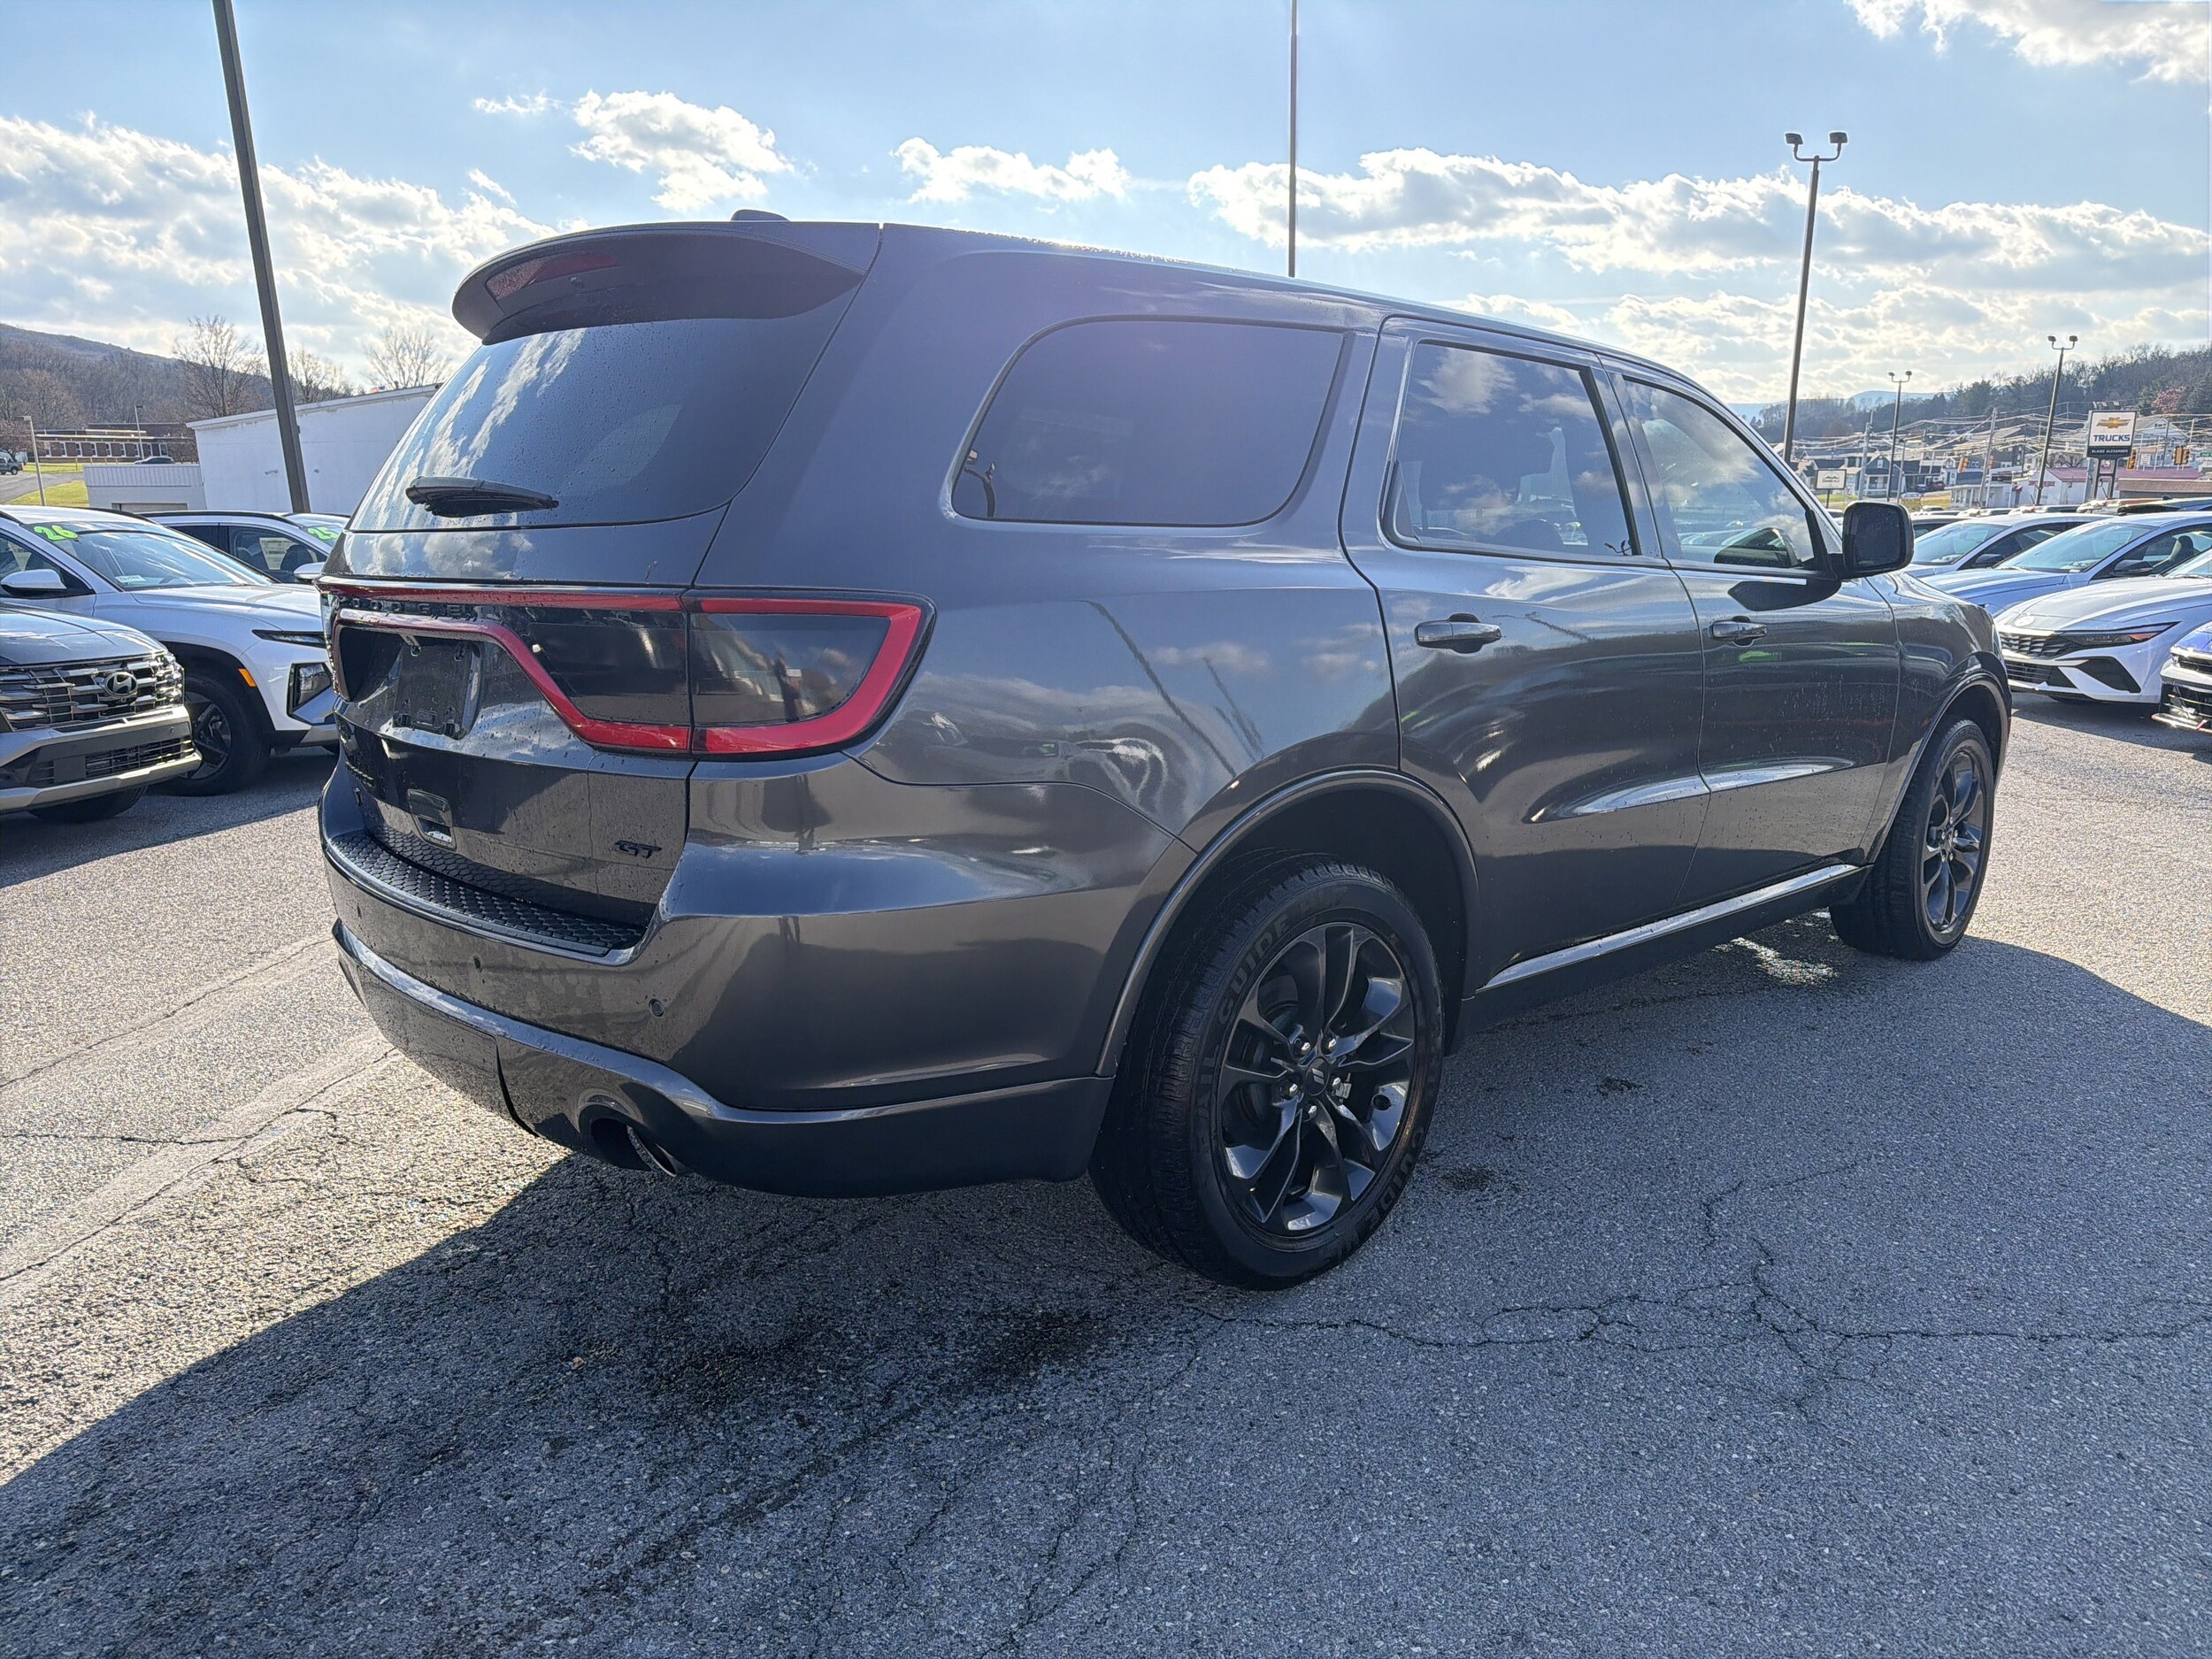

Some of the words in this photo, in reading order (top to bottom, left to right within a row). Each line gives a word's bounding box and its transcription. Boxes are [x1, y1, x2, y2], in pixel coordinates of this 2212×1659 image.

[34, 525, 78, 541] 26
[352, 597, 461, 616] DODGE
[615, 840, 662, 859] GT
[1218, 914, 1288, 1024] GUIDE
